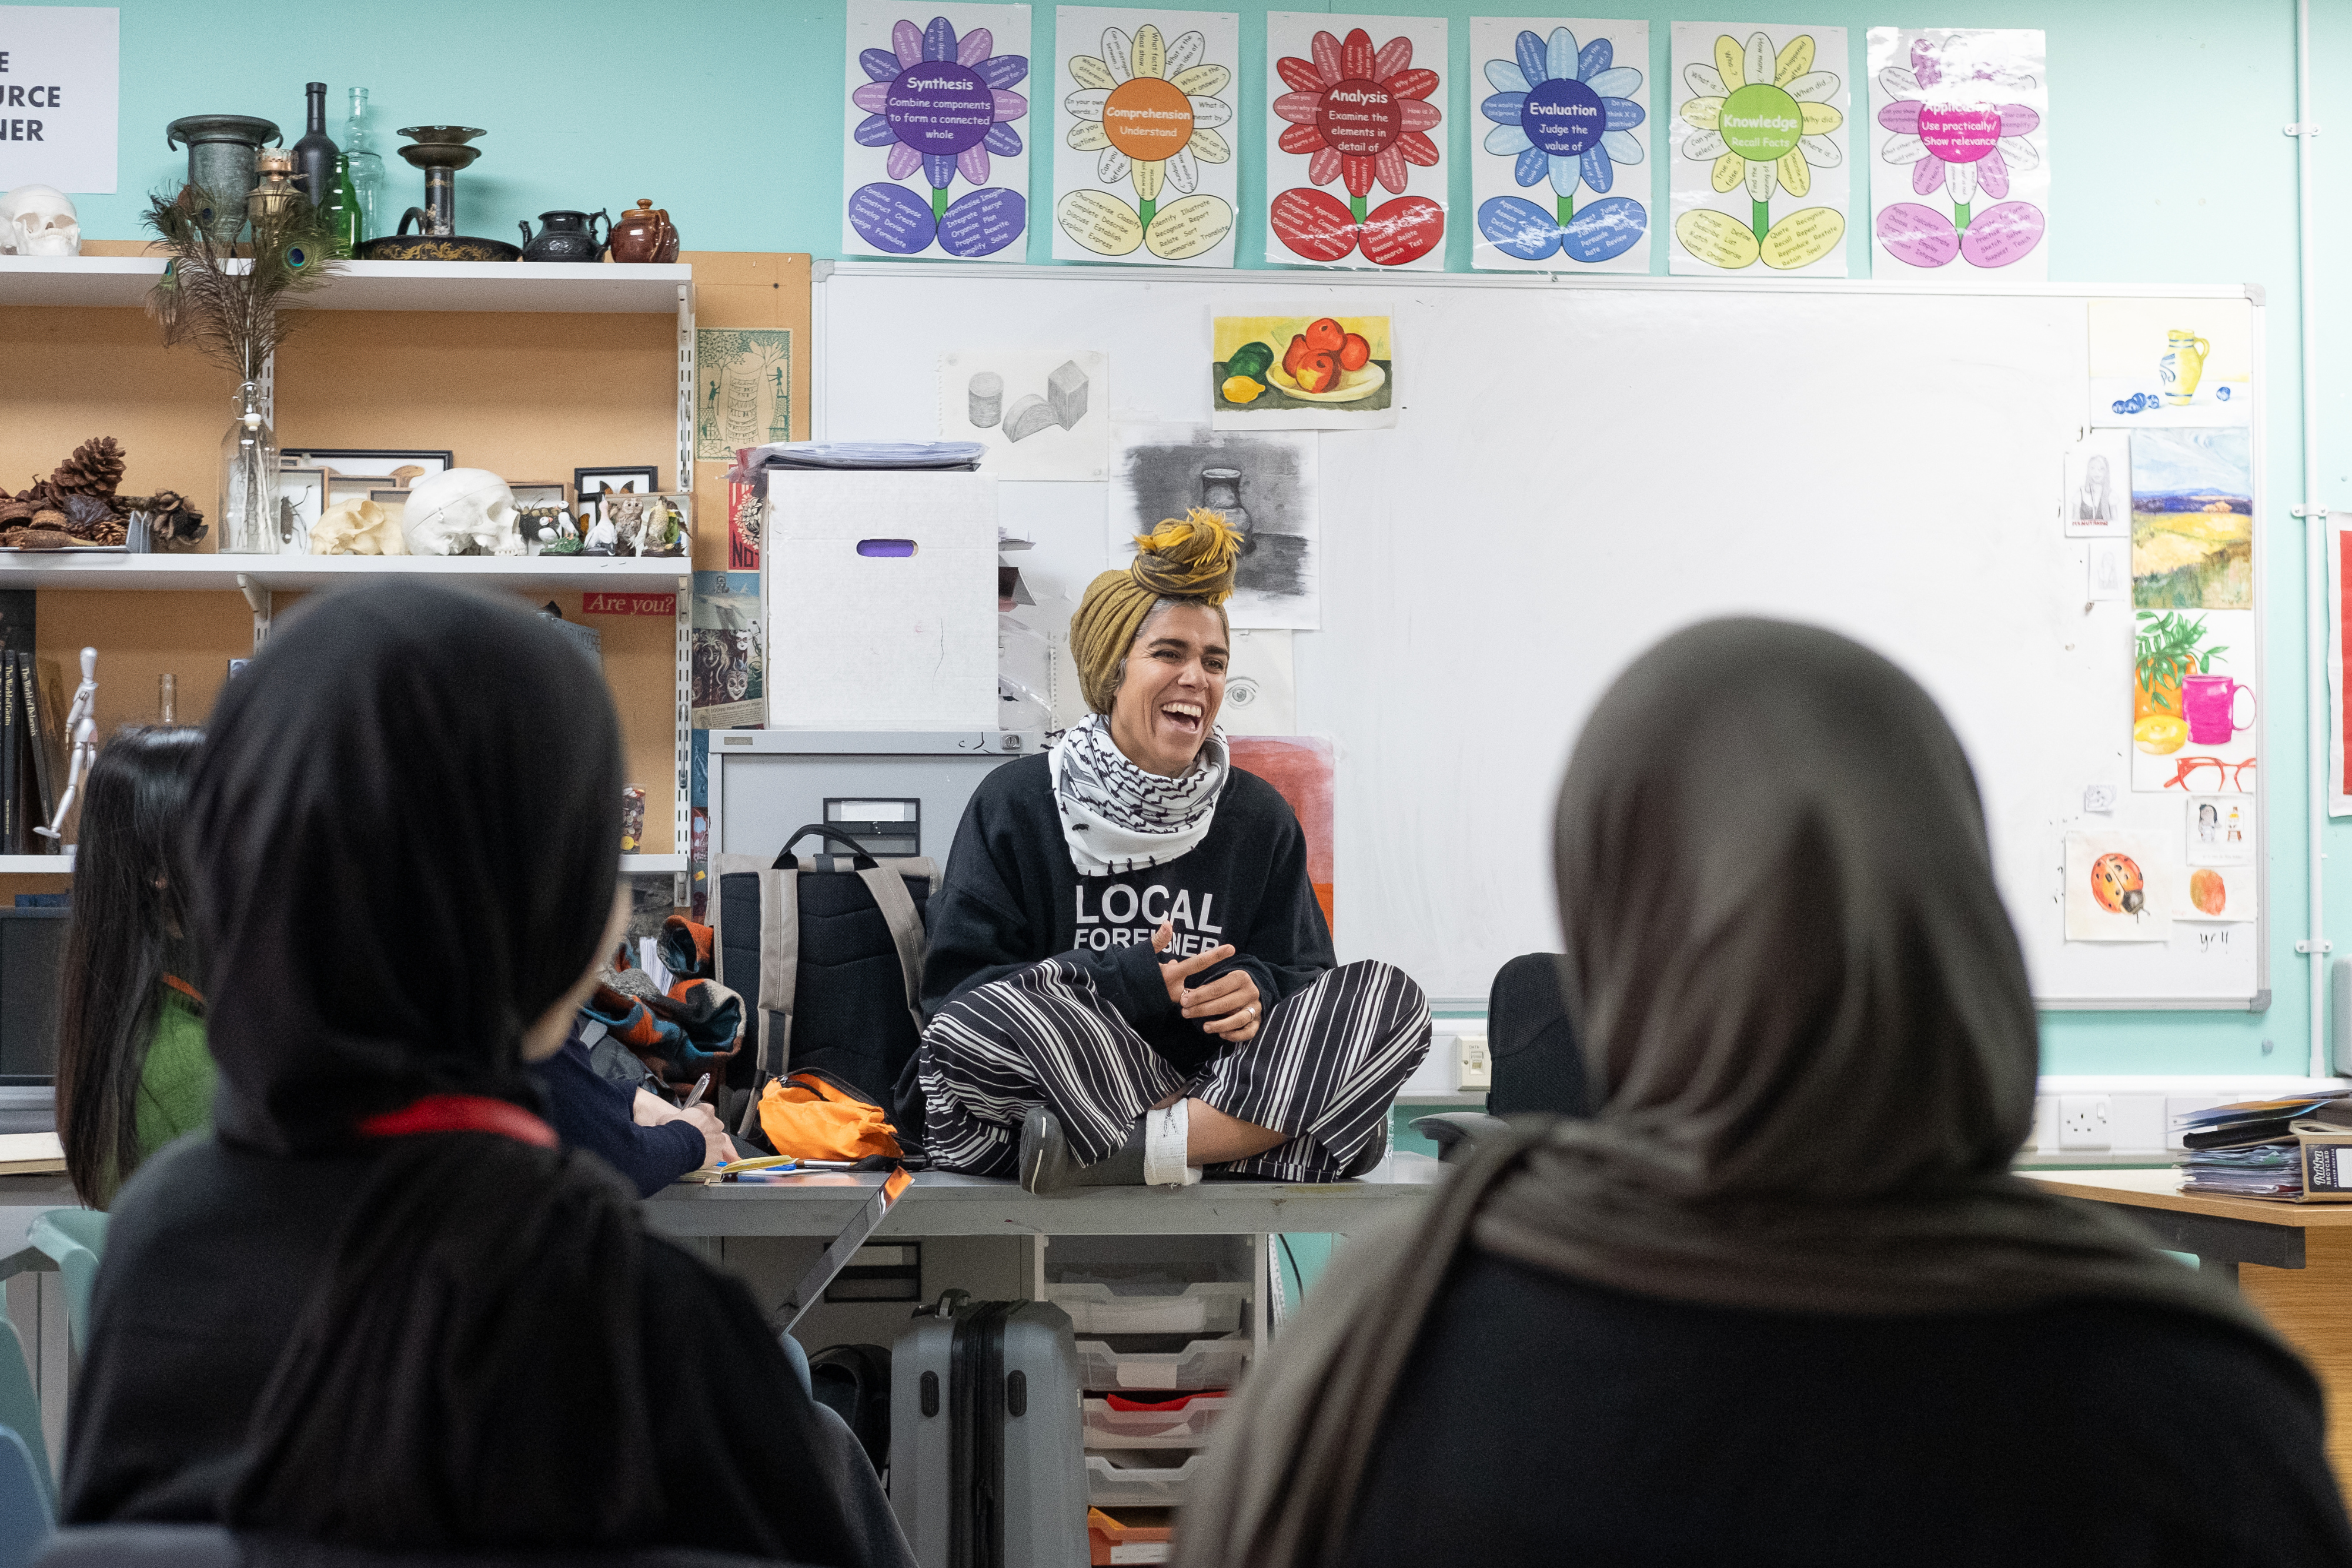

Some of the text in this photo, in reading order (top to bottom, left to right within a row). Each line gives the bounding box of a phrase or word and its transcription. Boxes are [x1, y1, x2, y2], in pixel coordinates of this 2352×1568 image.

[907, 77, 974, 92] Synthesis
[0, 85, 61, 108] RCE
[889, 98, 991, 111] Combine components
[1329, 89, 1388, 106] Analysis
[890, 113, 901, 122] to
[904, 113, 928, 123] form
[939, 116, 990, 125] connected
[1106, 107, 1191, 121] Comprehension
[1329, 111, 1389, 122] Examine the
[1529, 103, 1598, 116] Evaluation
[1120, 126, 1177, 137] Understand
[1331, 126, 1387, 138] elements in
[1539, 124, 1588, 136] Judge the
[1723, 114, 1798, 132] Knowledge
[1922, 121, 1997, 133] Use practically/
[926, 130, 954, 139] whole
[1732, 136, 1790, 148] Recall Facts
[1923, 136, 1997, 146] Show relevance
[1337, 142, 1379, 152] detail of
[1545, 141, 1583, 152] value of
[860, 195, 916, 228] Construct Create
[864, 186, 921, 219] Combine Compose
[1075, 192, 1141, 230] Characterise Classify
[856, 204, 905, 233] Develop Devise
[946, 200, 1003, 228] Integrate Merge
[1071, 200, 1128, 234] Complete Describe
[1151, 200, 1211, 229] Identify Illustrate
[951, 213, 997, 238] Organise Plan
[956, 220, 1010, 248] Propose Rewrite
[1062, 219, 1112, 250] Explain Express
[1066, 209, 1121, 242] Discuss Establish
[1155, 211, 1210, 238] Recognise Report
[1693, 221, 1737, 246] Describe List
[1770, 227, 1790, 239] Quote
[875, 228, 906, 248] Formulate
[959, 232, 1009, 256] Simplify Solve
[1160, 228, 1197, 248] Relate Sort
[1164, 225, 1230, 257] Summarise Translate
[1730, 228, 1752, 242] Define
[1773, 224, 1818, 249] Recall Repeat
[1371, 240, 1394, 253] Reason
[1375, 238, 1424, 263] Research Test
[1778, 240, 1809, 258] Reproduce
[1781, 244, 1822, 266] Retain Spell
[588, 594, 674, 616] Are you?
[24, 680, 33, 698] World
[1076, 884, 1222, 934] LOCAL
[2313, 1151, 2326, 1185] Pukka
